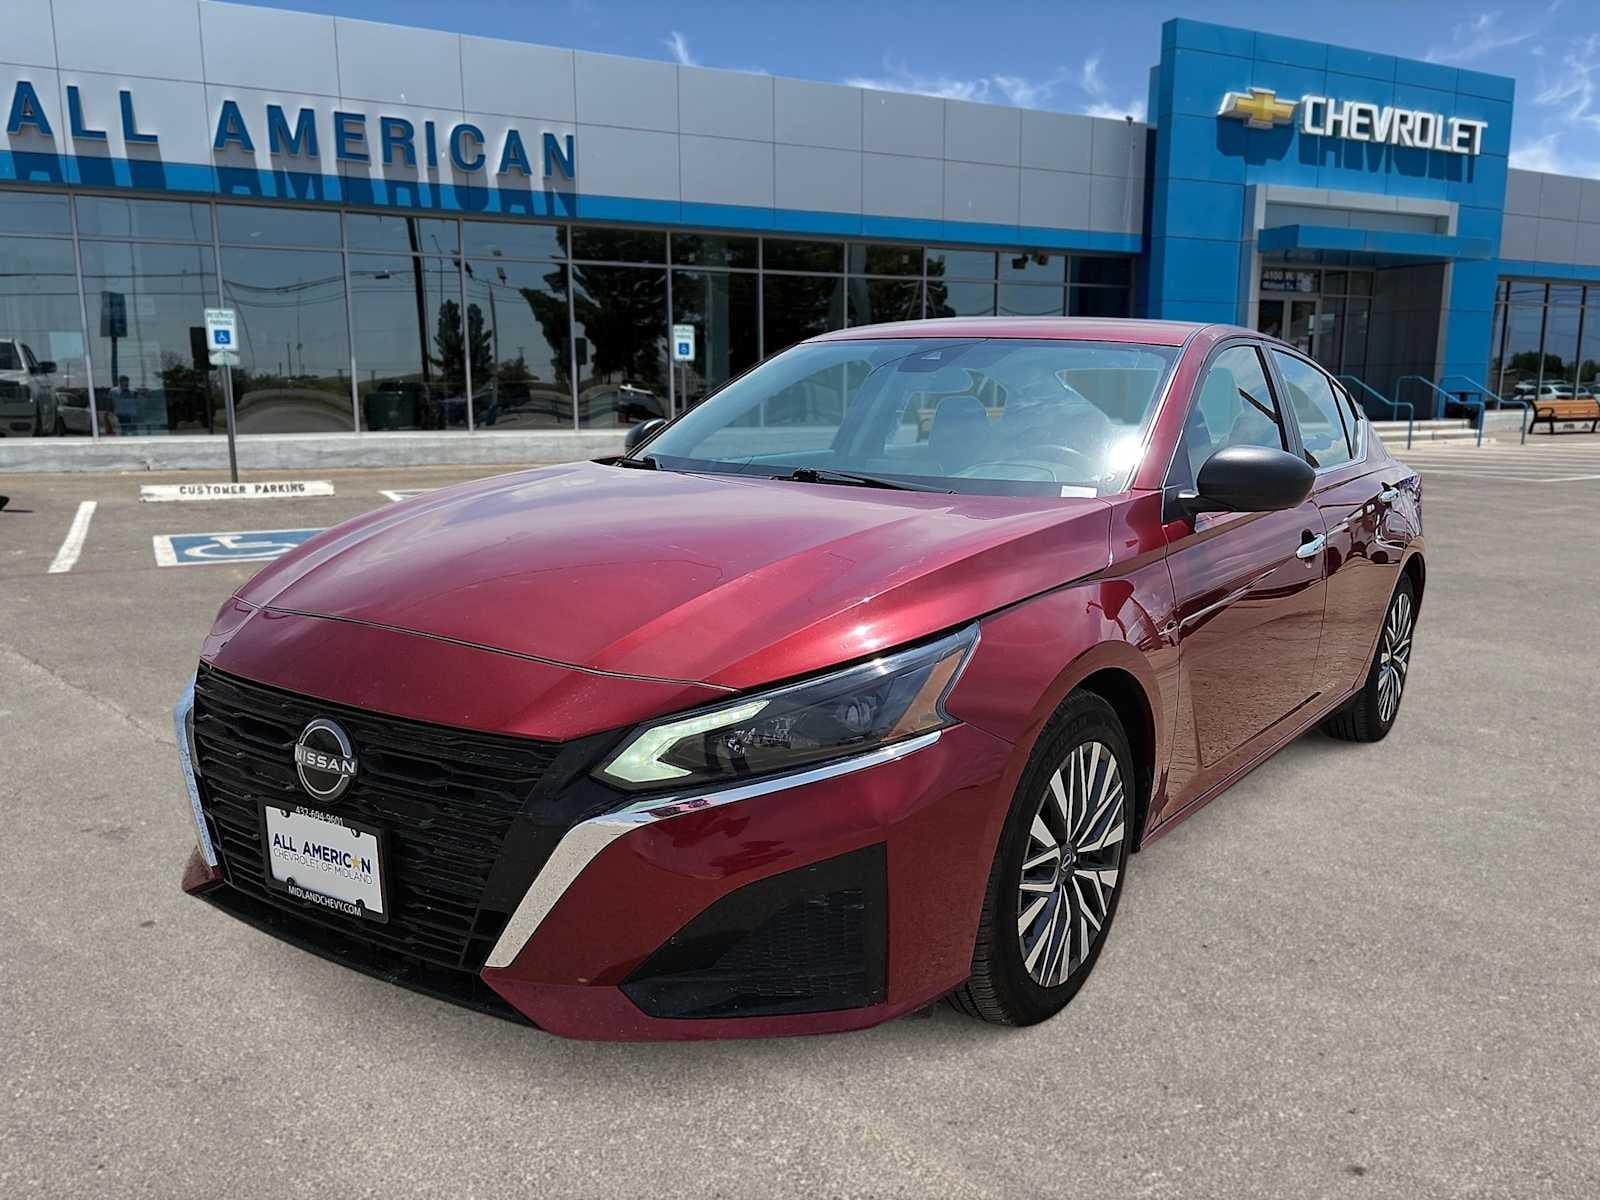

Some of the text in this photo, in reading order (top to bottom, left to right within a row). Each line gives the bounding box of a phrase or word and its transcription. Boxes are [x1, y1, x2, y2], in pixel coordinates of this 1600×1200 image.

[5, 79, 577, 181] ALL AMERICAN
[1301, 94, 1489, 156] CHEVROLET
[178, 483, 306, 496] CUSTOMER PARKING
[294, 743, 356, 774] NISSAN
[272, 832, 371, 874] ALL AMERICN
[273, 847, 374, 885] CHEVROLET OF MIDLAND
[287, 884, 363, 918] MIDLANDCHEVY.COM
